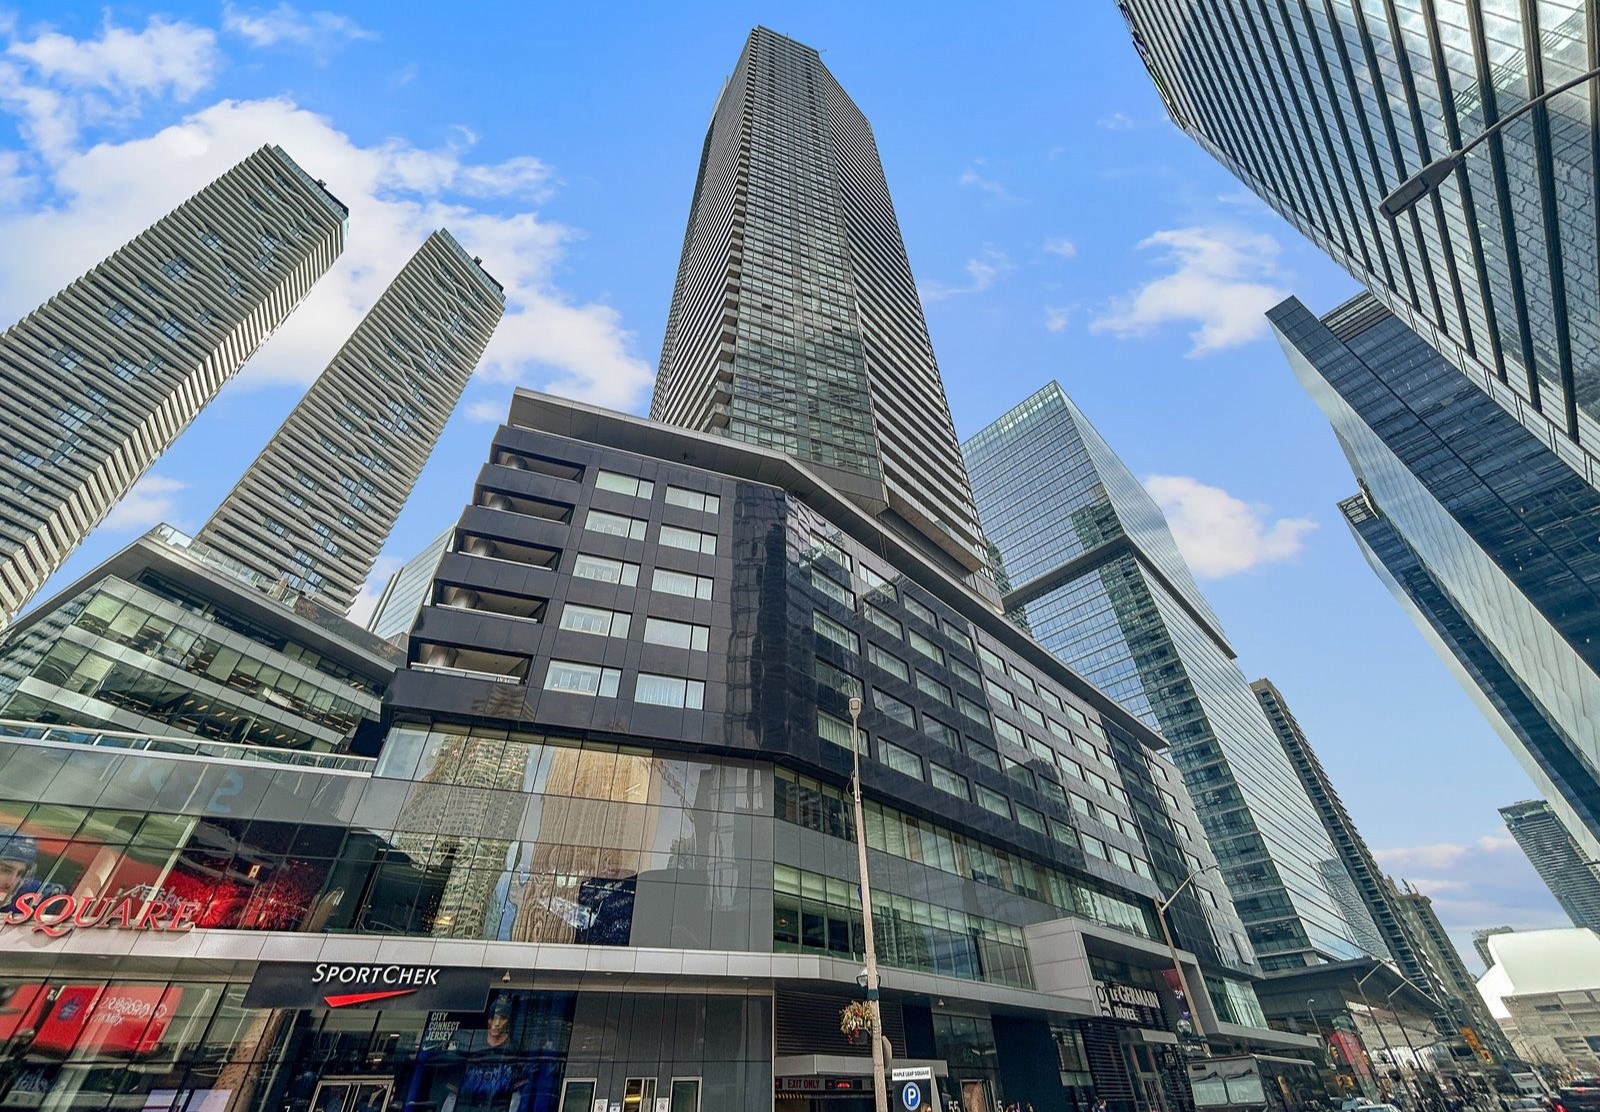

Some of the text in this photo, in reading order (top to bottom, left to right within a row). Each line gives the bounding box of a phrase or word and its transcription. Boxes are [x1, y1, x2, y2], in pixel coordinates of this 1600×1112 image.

[5, 892, 198, 937] SQUARE
[1118, 985, 1160, 1009] GERMAIN
[431, 1012, 448, 1021] CITY
[429, 1021, 460, 1031] CONNECT
[425, 1031, 452, 1041] JERSEY
[787, 1079, 820, 1089] EXIT ONLY
